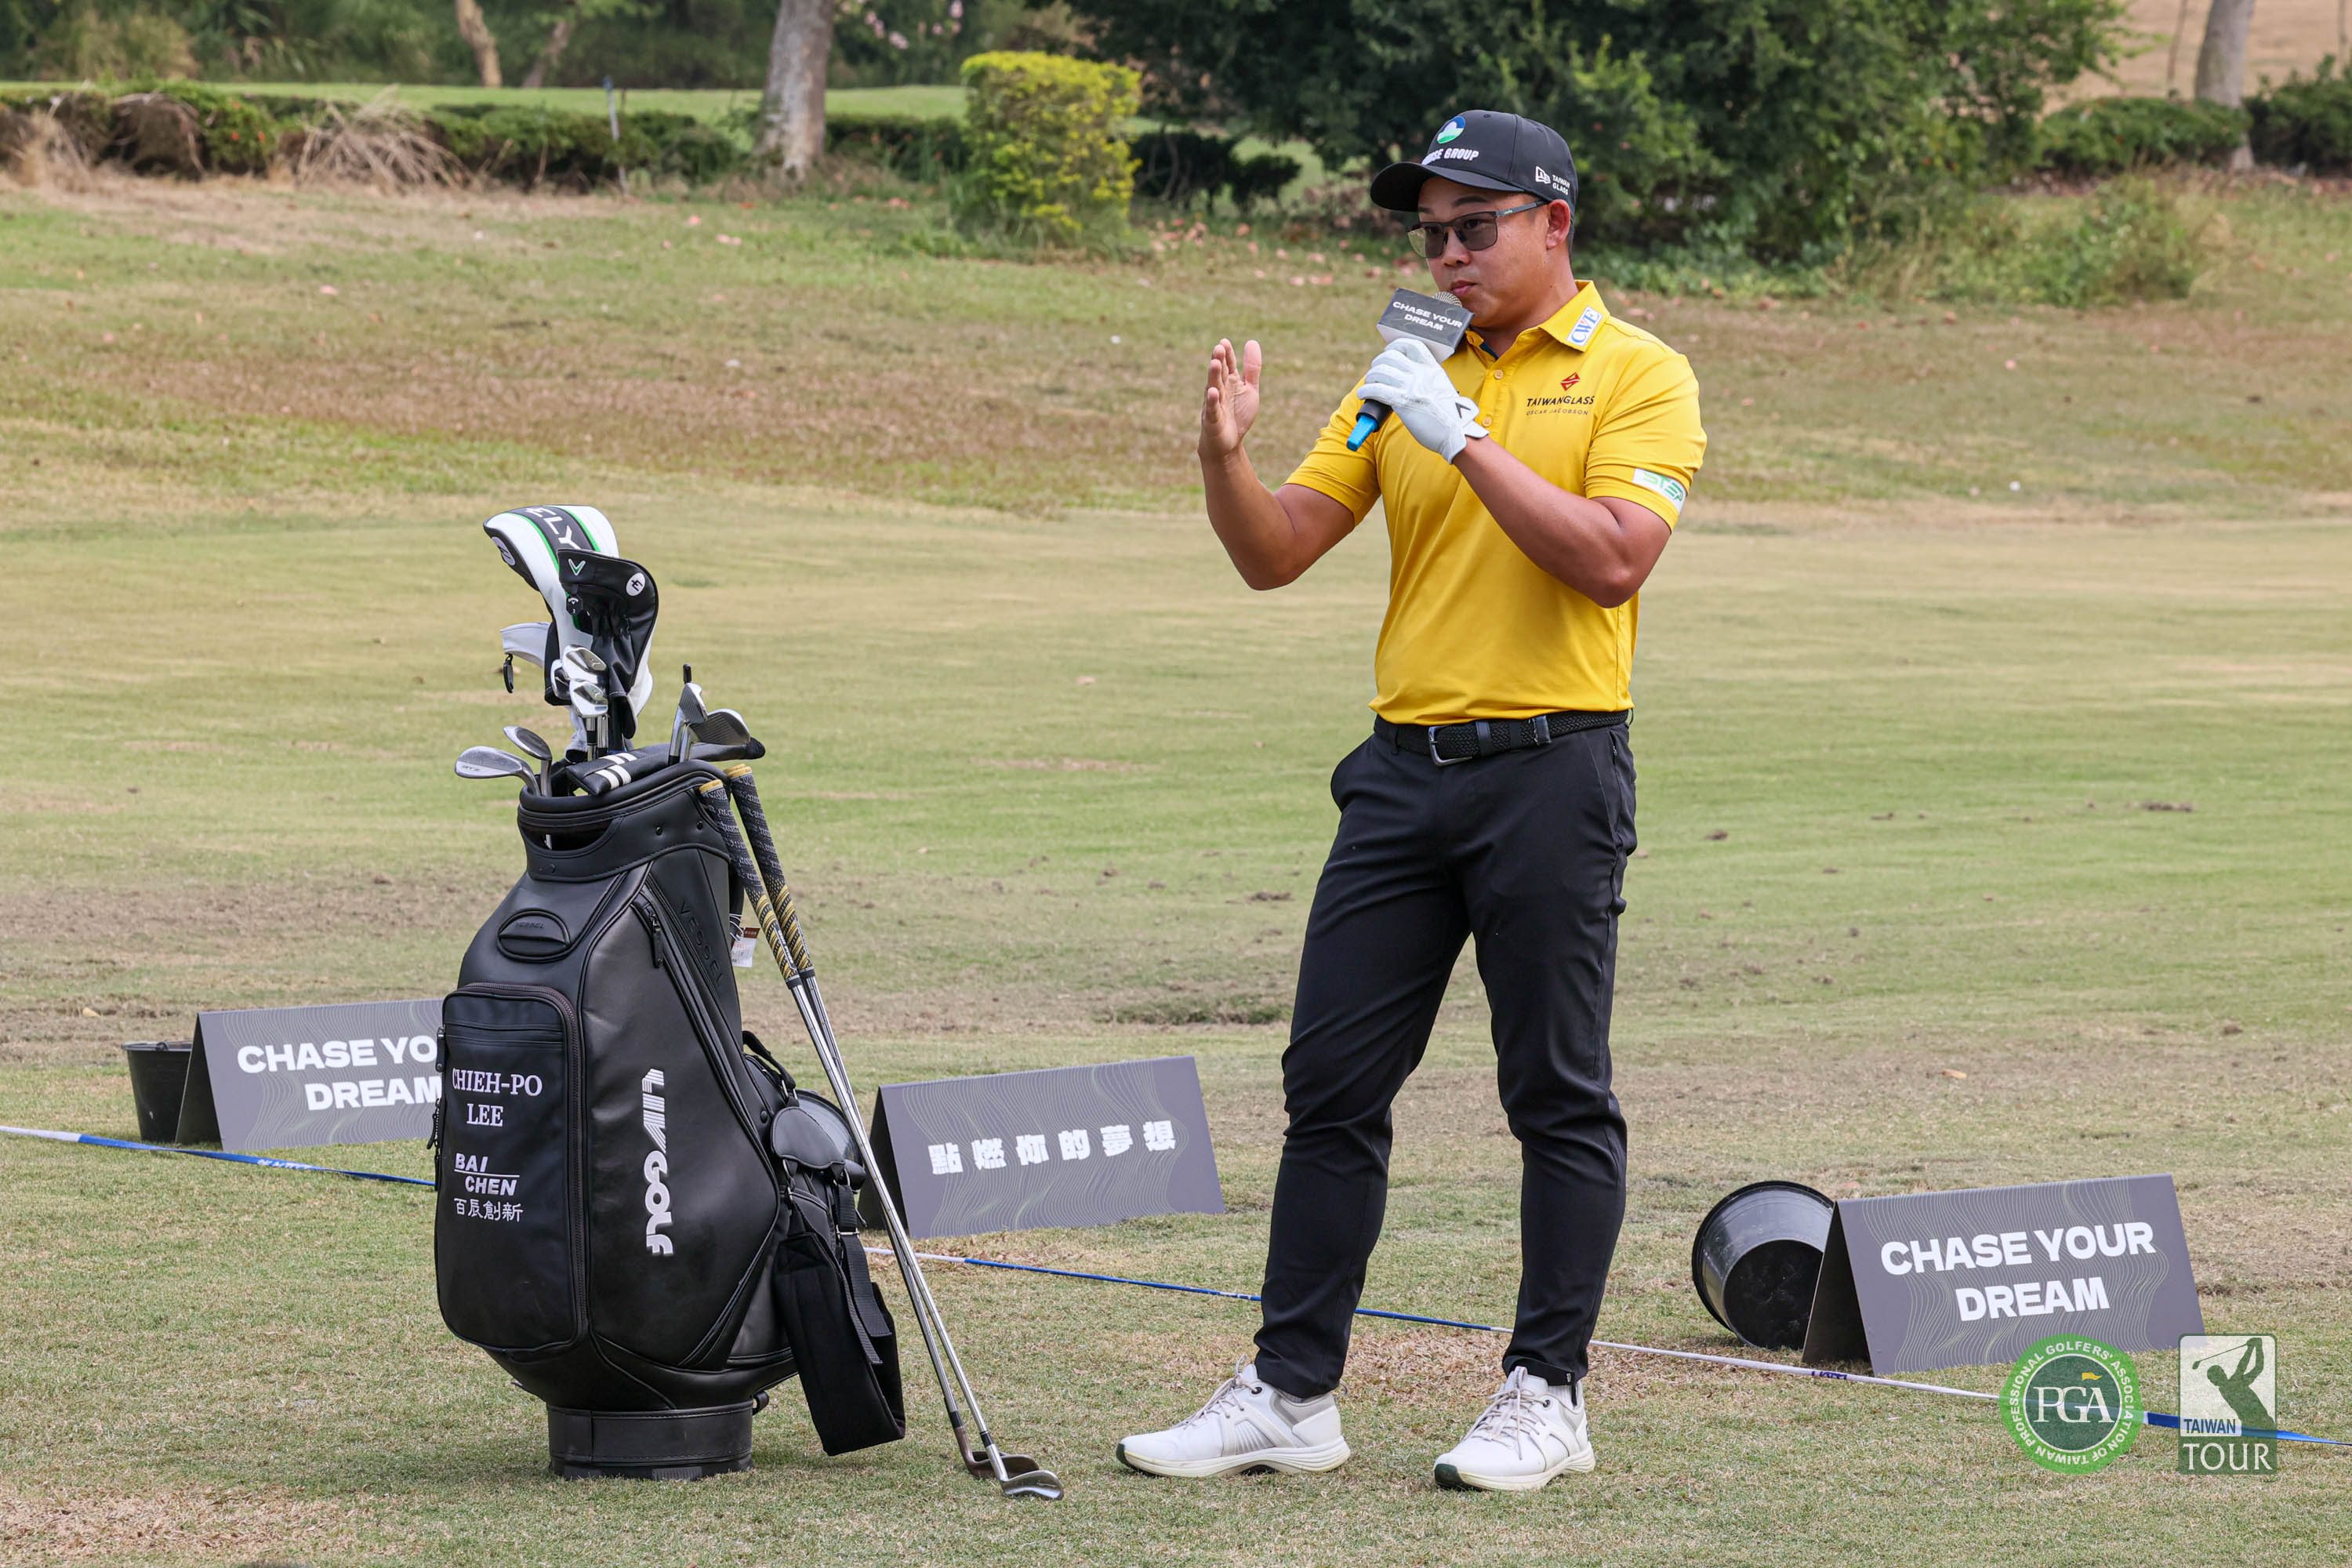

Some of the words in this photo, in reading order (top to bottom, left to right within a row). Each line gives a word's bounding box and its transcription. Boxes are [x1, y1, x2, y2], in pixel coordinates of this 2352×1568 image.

[1444, 148, 1479, 162] GROUP
[1552, 174, 1570, 189] TAIWAN
[1392, 301, 1432, 318] CHASE
[1432, 313, 1463, 328] YOUR
[1404, 314, 1444, 331] DREAM
[237, 1038, 379, 1074] CHASE
[303, 1076, 443, 1111] DREAM
[452, 1068, 543, 1097] CHIEH-PO
[466, 1103, 504, 1127] LEE
[641, 1069, 666, 1154] LIV
[927, 1120, 1177, 1175] 點燃你的夢想
[455, 1152, 488, 1173] BAI
[464, 1176, 517, 1196] CHEN
[453, 1197, 524, 1223] 百辰創新
[644, 1149, 673, 1256] GOLF
[1881, 1231, 2033, 1276] CHASE
[2033, 1221, 2157, 1261] YOUR
[1955, 1276, 2111, 1322] DREAM
